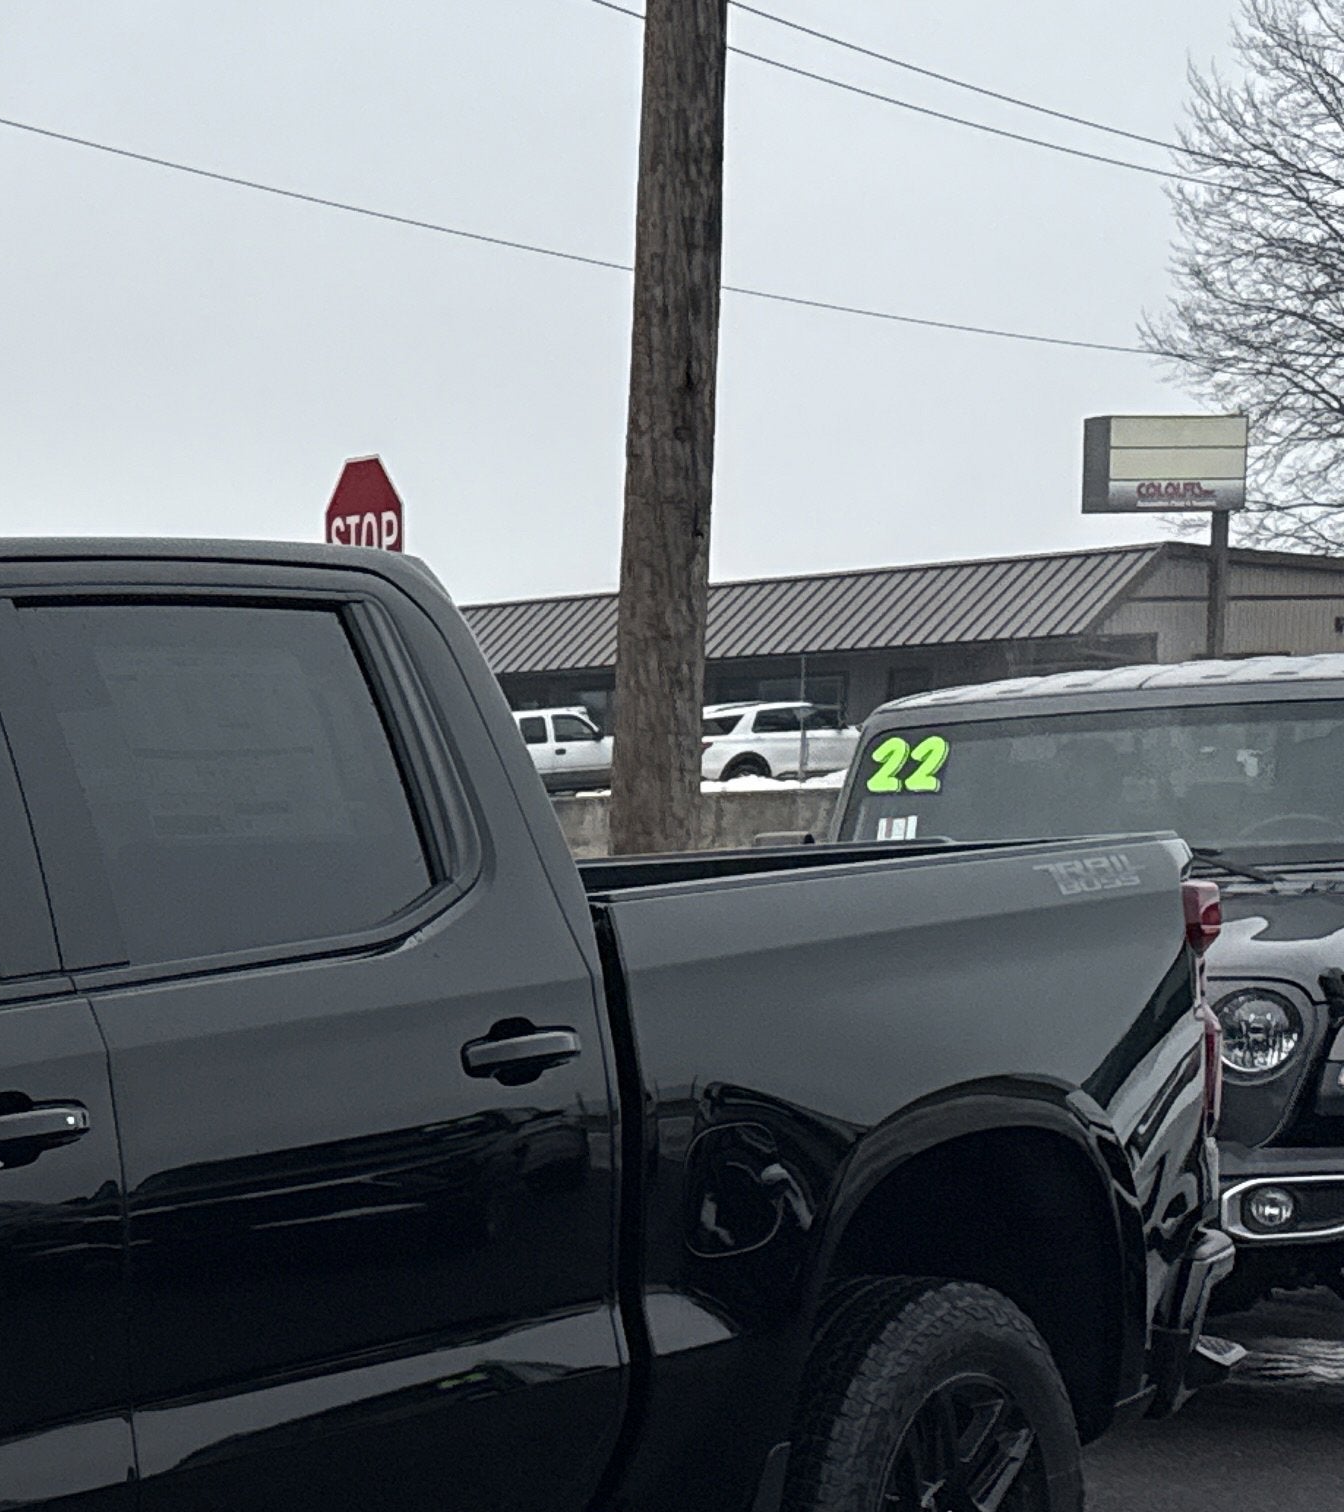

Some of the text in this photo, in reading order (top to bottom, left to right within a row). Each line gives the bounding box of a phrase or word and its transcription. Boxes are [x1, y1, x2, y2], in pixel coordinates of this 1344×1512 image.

[331, 510, 398, 550] STOP
[867, 736, 949, 793] 22
[1032, 854, 1146, 882] TRAIL
[1060, 873, 1141, 895] BOSS
